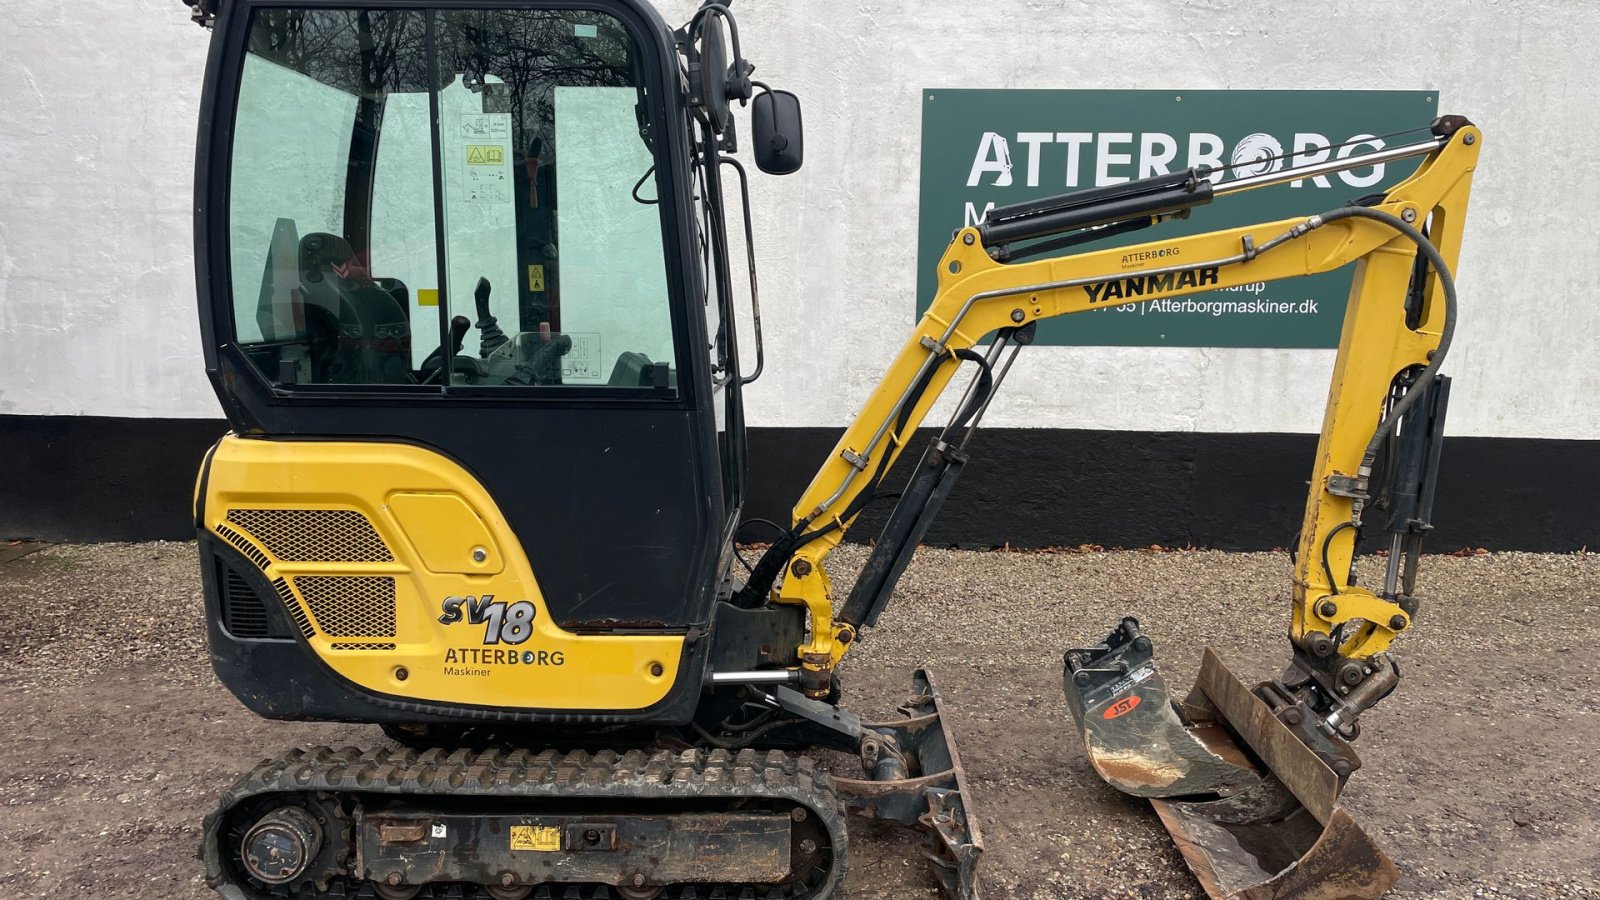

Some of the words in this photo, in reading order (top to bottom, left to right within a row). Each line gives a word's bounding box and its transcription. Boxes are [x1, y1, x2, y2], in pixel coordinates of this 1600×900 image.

[966, 132, 1386, 188] ATTERBORG
[1121, 247, 1180, 264] ATTERBORG
[1083, 266, 1219, 303] YANMAR
[1149, 299, 1318, 317] Atterborgmaskiner.dk
[444, 648, 565, 666] ATTERBORG
[443, 667, 492, 677] Maskiner
